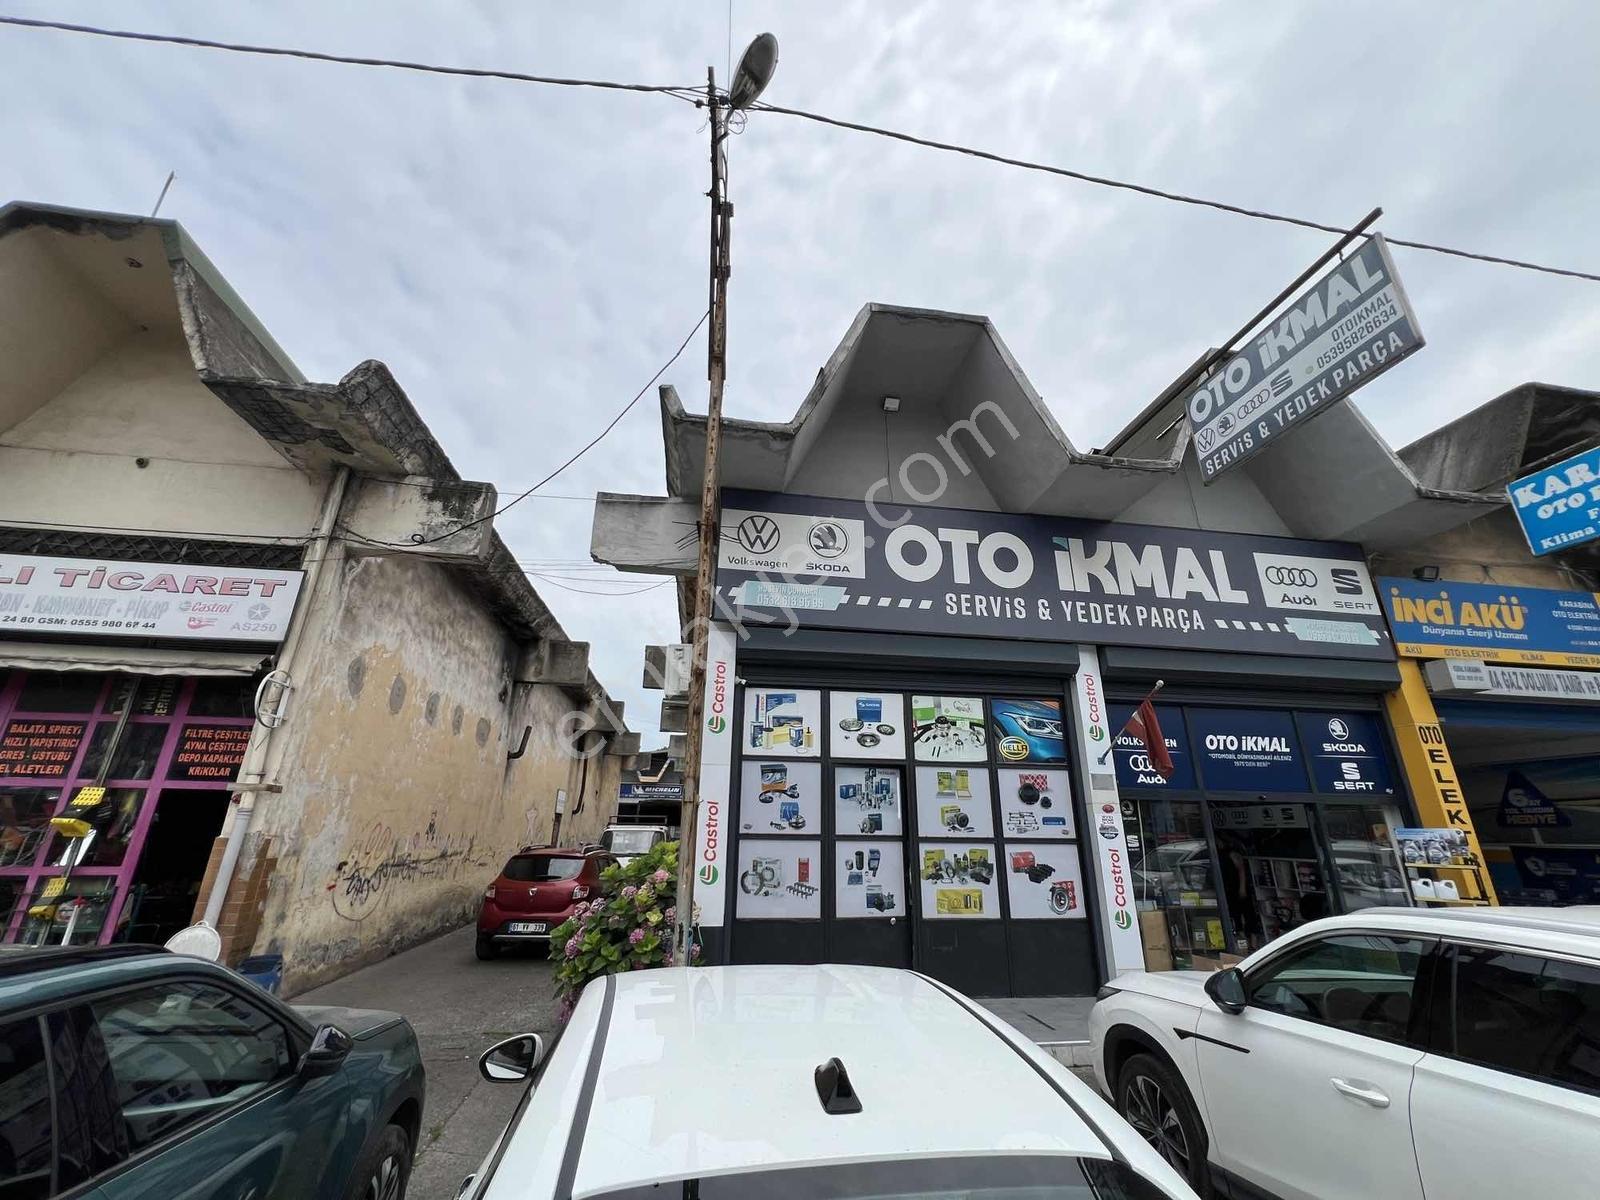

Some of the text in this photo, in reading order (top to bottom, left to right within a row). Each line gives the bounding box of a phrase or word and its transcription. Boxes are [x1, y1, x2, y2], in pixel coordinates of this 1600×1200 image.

[1331, 292, 1393, 342] OTOIKMAL
[1316, 304, 1398, 369] 05395826634
[1274, 378, 1334, 428] YEDEK
[1333, 331, 1405, 388] PARÇA
[1189, 357, 1251, 423] OTO
[1513, 456, 1600, 508] KAR
[1537, 492, 1586, 519] OTO
[1540, 526, 1597, 549] Klima
[728, 556, 789, 569] Volkswagen
[885, 524, 1035, 589] OTO
[54, 566, 287, 598] TİCARET
[1281, 593, 1317, 607] Audi
[1333, 601, 1374, 611] SEAT
[191, 602, 233, 614] Castrol
[1391, 587, 1525, 631] İNCİ AKÜ
[20, 616, 35, 624] 80
[38, 617, 67, 625] GSM:
[71, 619, 98, 627] 0555
[101, 620, 122, 628] 980
[1038, 599, 1053, 621] &
[1061, 601, 1132, 627] YEDEK
[1137, 605, 1206, 633] PARÇA
[230, 622, 277, 632] AS250
[1466, 628, 1493, 639] Enerji
[1444, 649, 1461, 657] OTO
[713, 661, 727, 714] Castrol
[1083, 674, 1100, 723] Castrol
[9, 724, 46, 734] BALATA
[1418, 726, 1443, 744] OTO
[3, 738, 28, 746] HIZLI
[184, 741, 207, 750] AYNA
[1003, 744, 1028, 752] HELLA
[1116, 736, 1177, 748] VOLKSEN
[1205, 734, 1238, 751] OTO
[1322, 743, 1366, 753] SKODA
[178, 754, 201, 762] DEPO
[1137, 774, 1167, 785] Audi
[1334, 781, 1375, 791] SEAT
[704, 801, 719, 862] Castrol
[1108, 849, 1127, 907] Castrol
